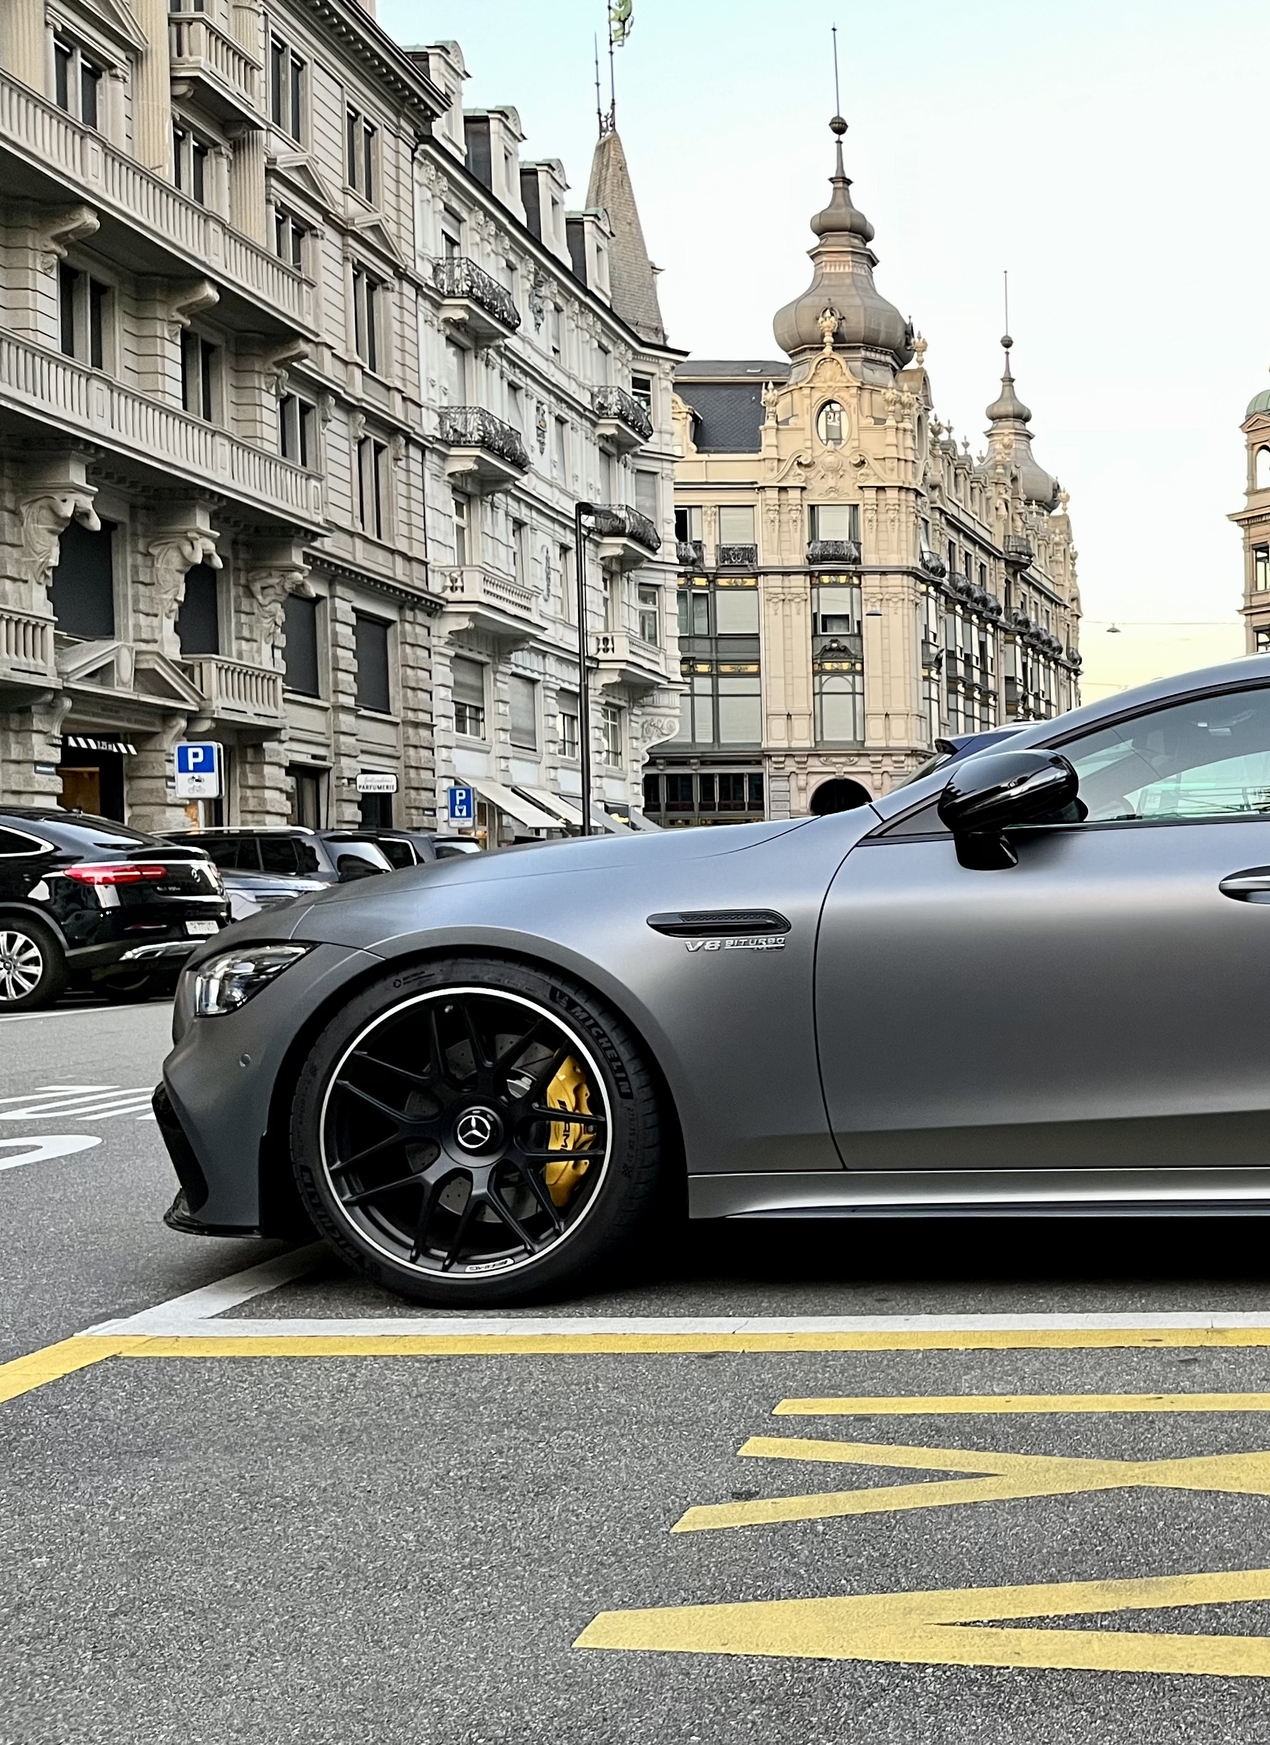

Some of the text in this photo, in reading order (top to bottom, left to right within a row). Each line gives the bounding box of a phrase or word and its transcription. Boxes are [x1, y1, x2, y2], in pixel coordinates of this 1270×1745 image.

[187, 747, 204, 771] P
[456, 789, 466, 805] P
[724, 937, 785, 947] BITURBO
[570, 1004, 631, 1094] MICHELIN
[303, 1171, 361, 1259] MICHELIN
